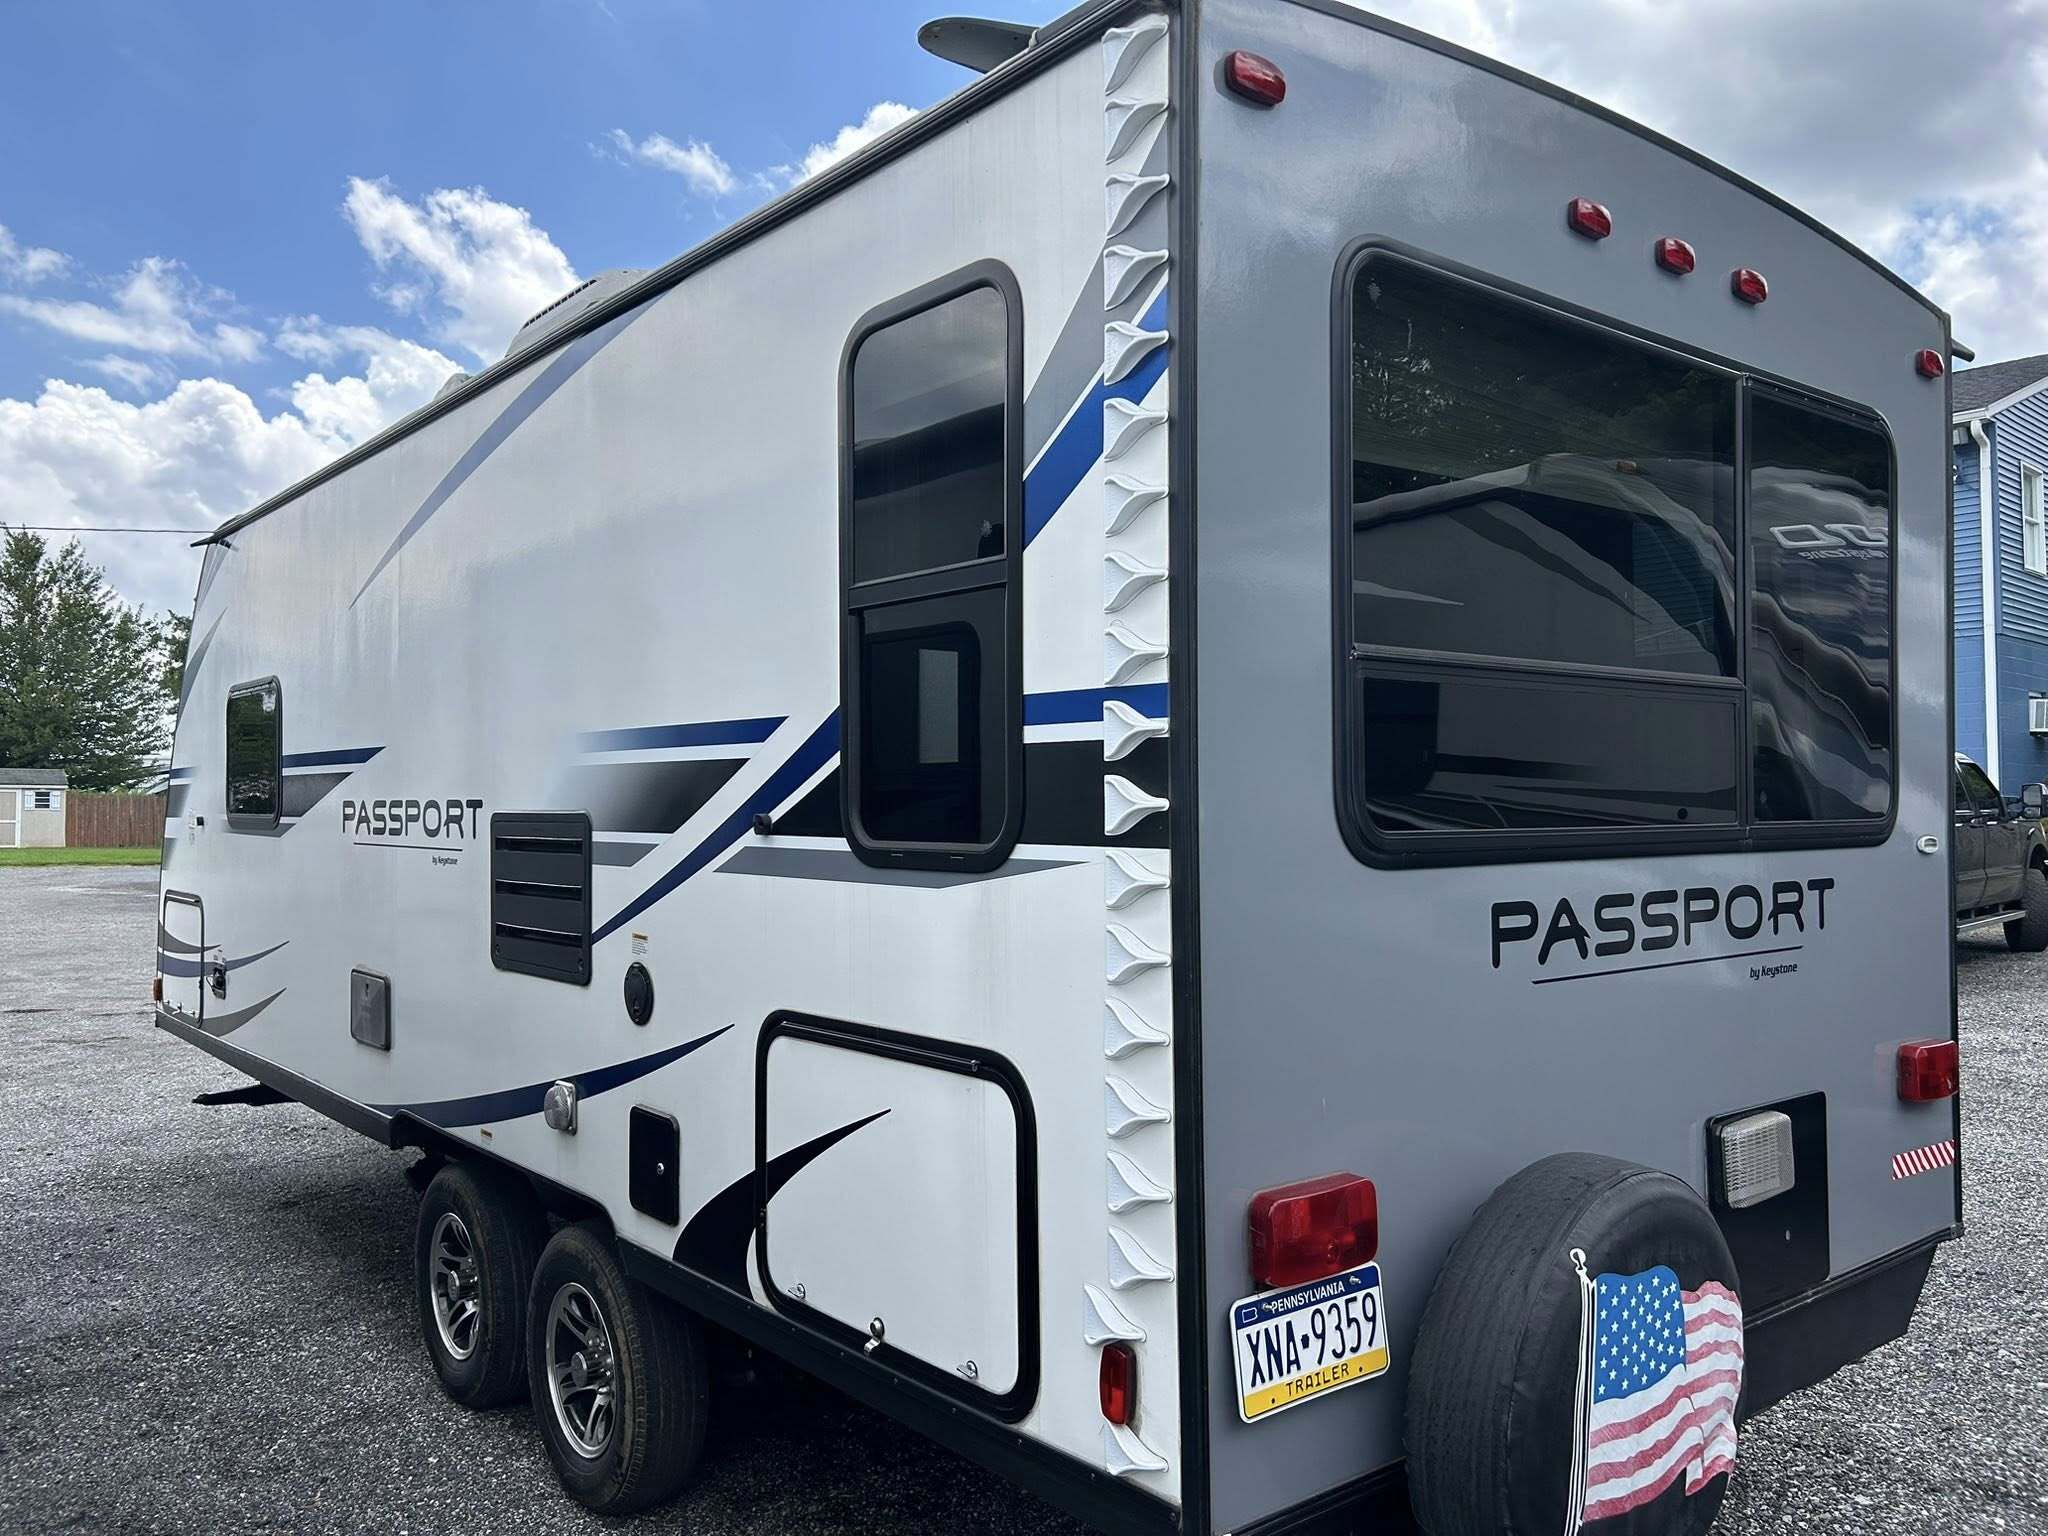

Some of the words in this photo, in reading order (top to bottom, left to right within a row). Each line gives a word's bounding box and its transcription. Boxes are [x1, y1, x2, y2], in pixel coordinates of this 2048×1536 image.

[342, 799, 484, 840] PASSPORT
[1491, 877, 1835, 970] PASSPORT
[1750, 966, 1760, 981] by
[1761, 963, 1798, 979] Keystone
[1270, 1280, 1345, 1314] PENNSYLVANIA
[1285, 1362, 1350, 1397] TRAILER
